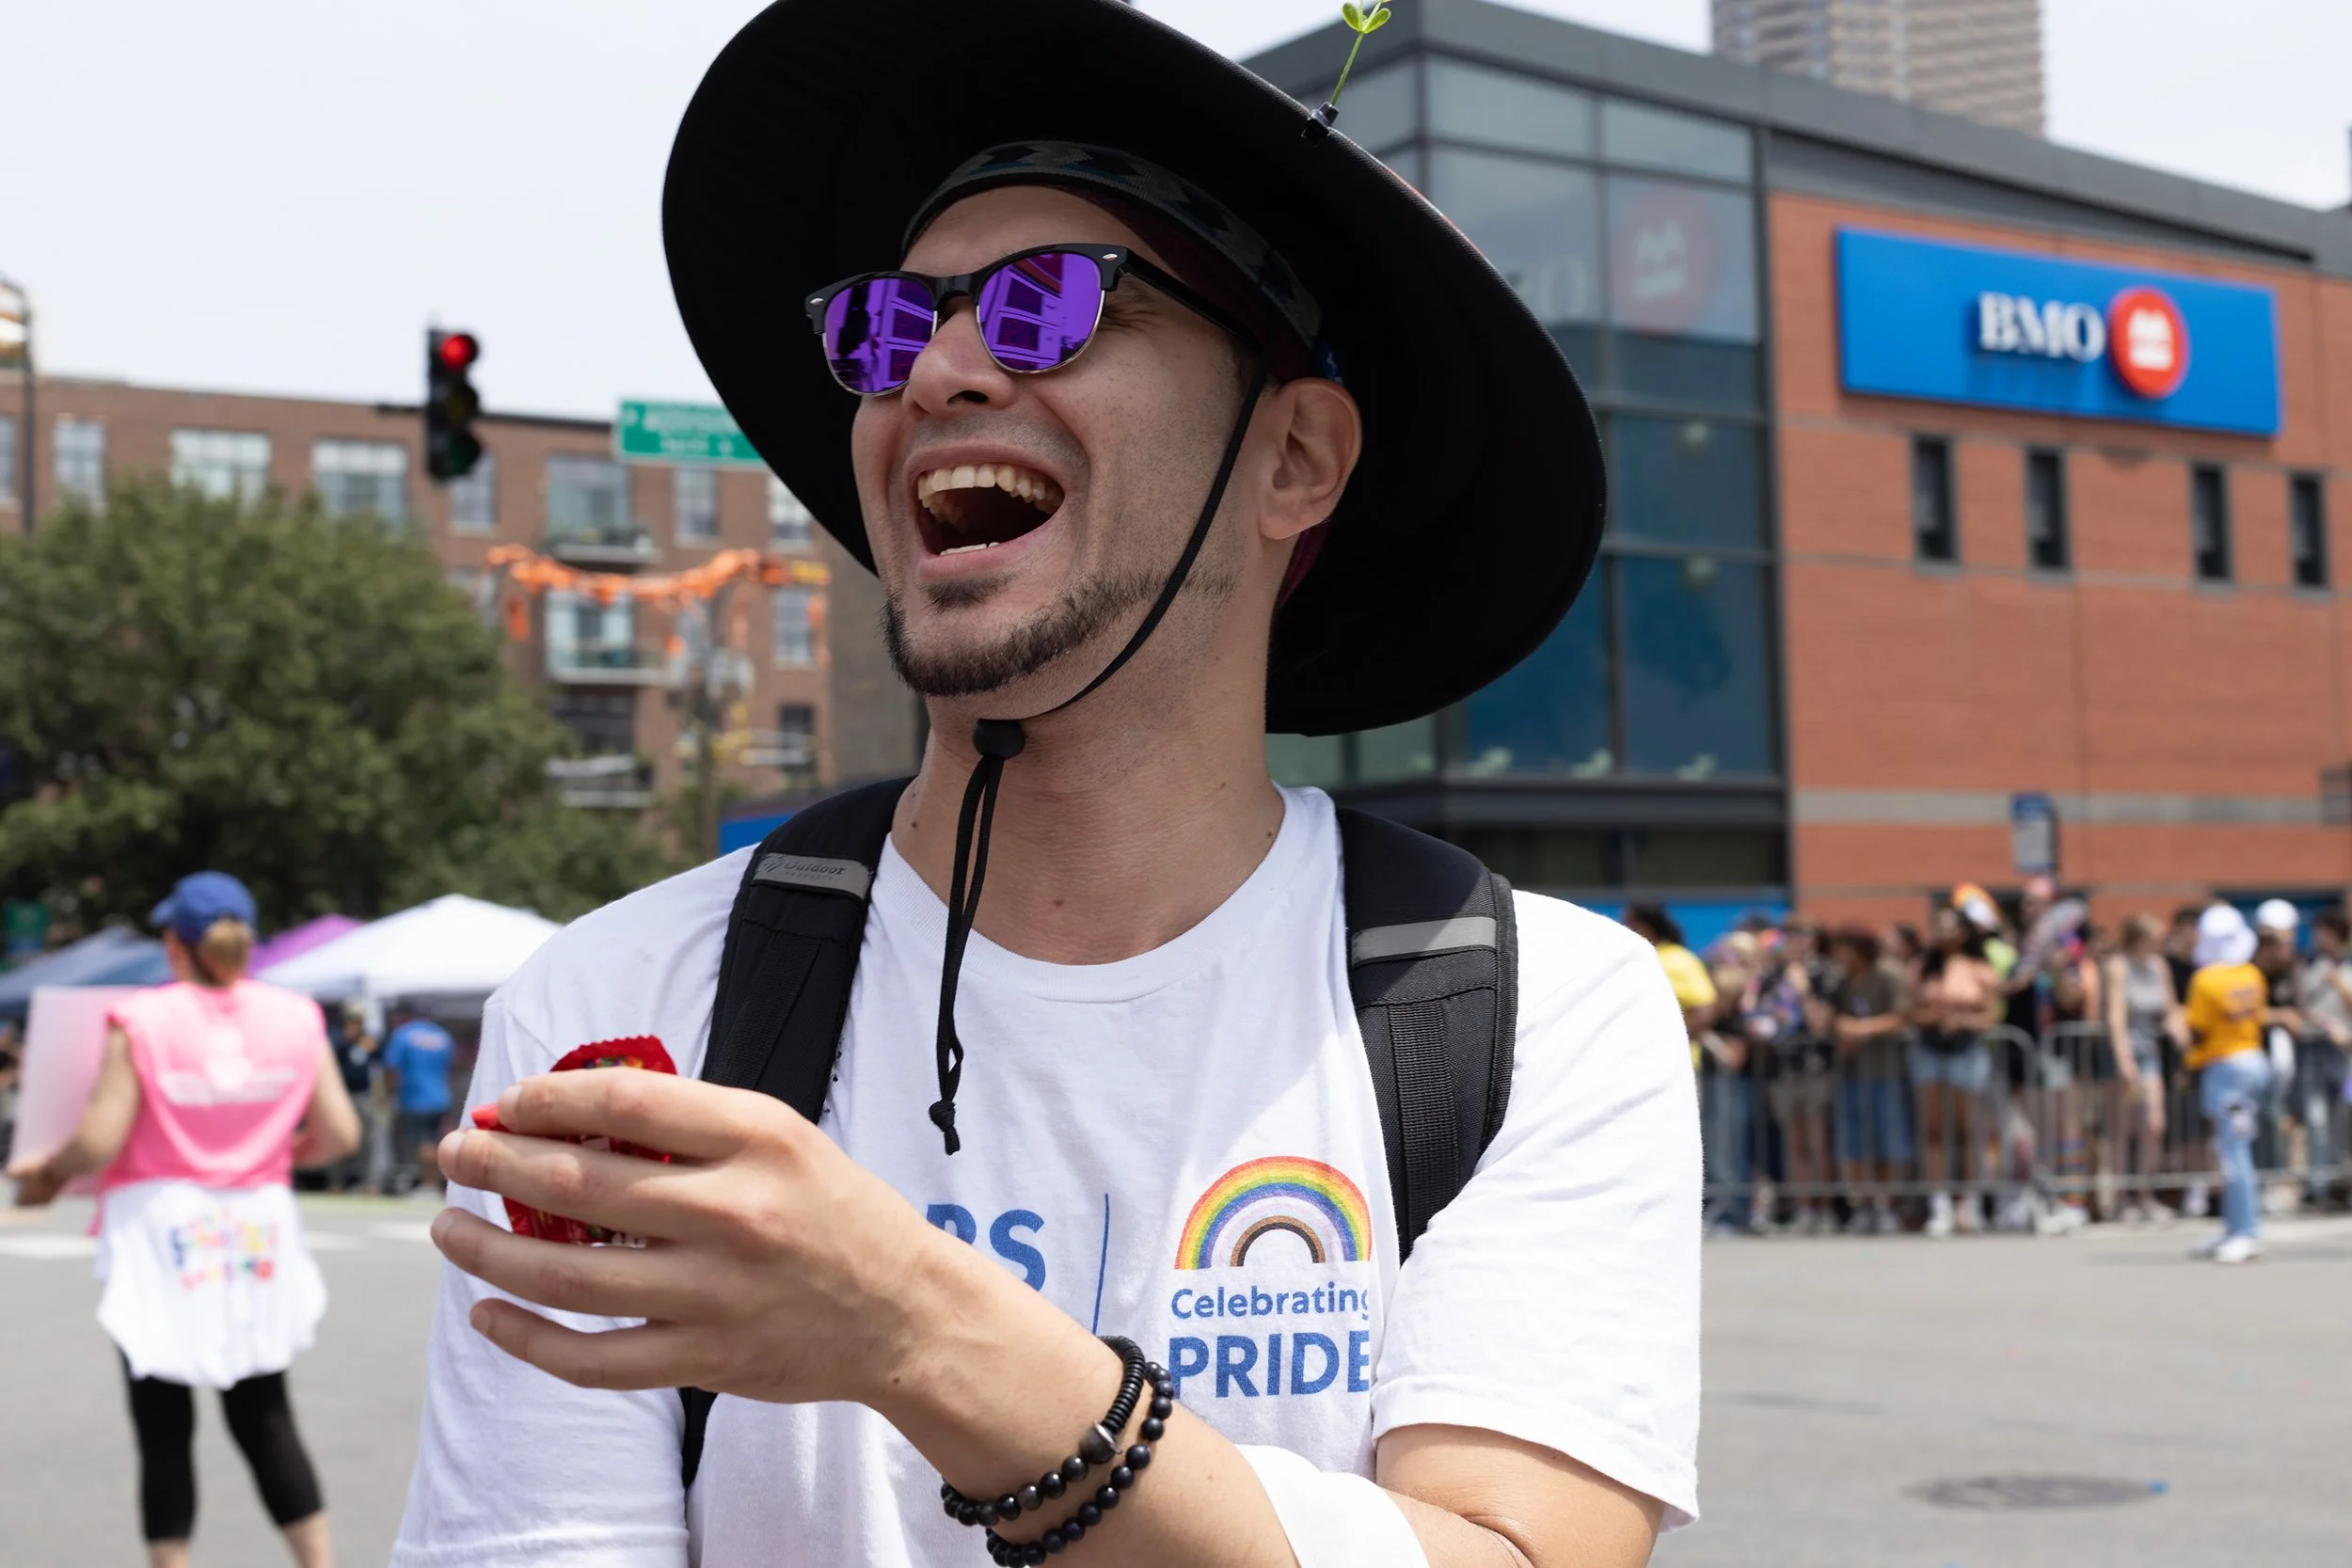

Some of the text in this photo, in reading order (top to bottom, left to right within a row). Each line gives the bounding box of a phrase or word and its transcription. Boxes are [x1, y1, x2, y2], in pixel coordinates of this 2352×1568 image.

[1979, 292, 2106, 362] BMO
[784, 862, 847, 876] Outdoor
[1168, 1329, 1370, 1400] PRIDE
